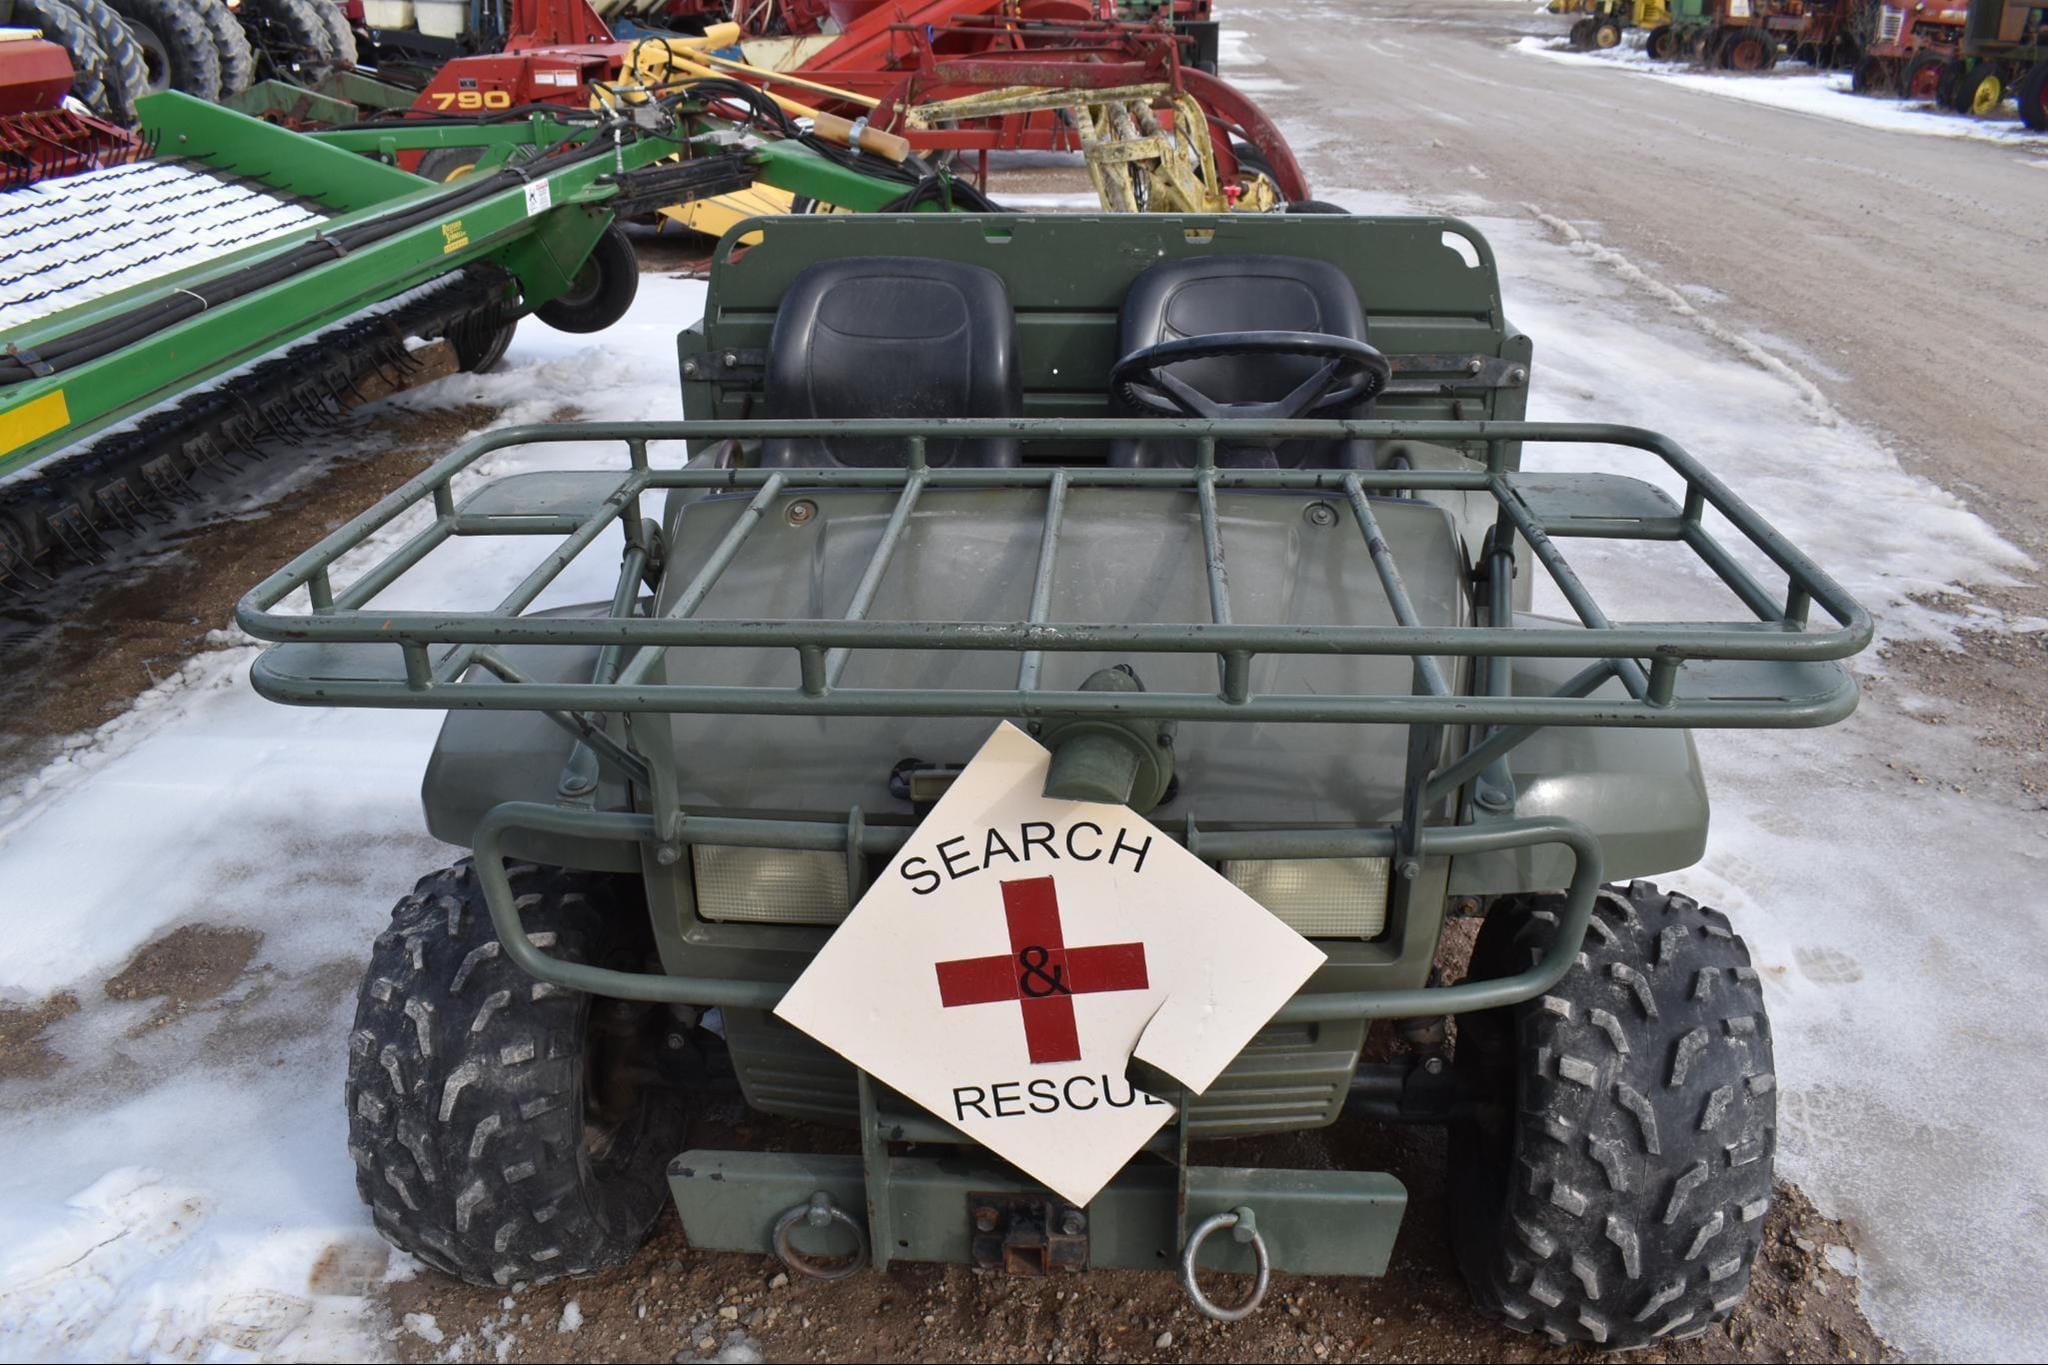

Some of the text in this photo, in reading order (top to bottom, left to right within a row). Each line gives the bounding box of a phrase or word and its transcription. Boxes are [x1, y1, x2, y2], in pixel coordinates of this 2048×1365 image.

[431, 90, 511, 111] 790
[899, 820, 1153, 895] SEARCH
[1018, 945, 1073, 998] &
